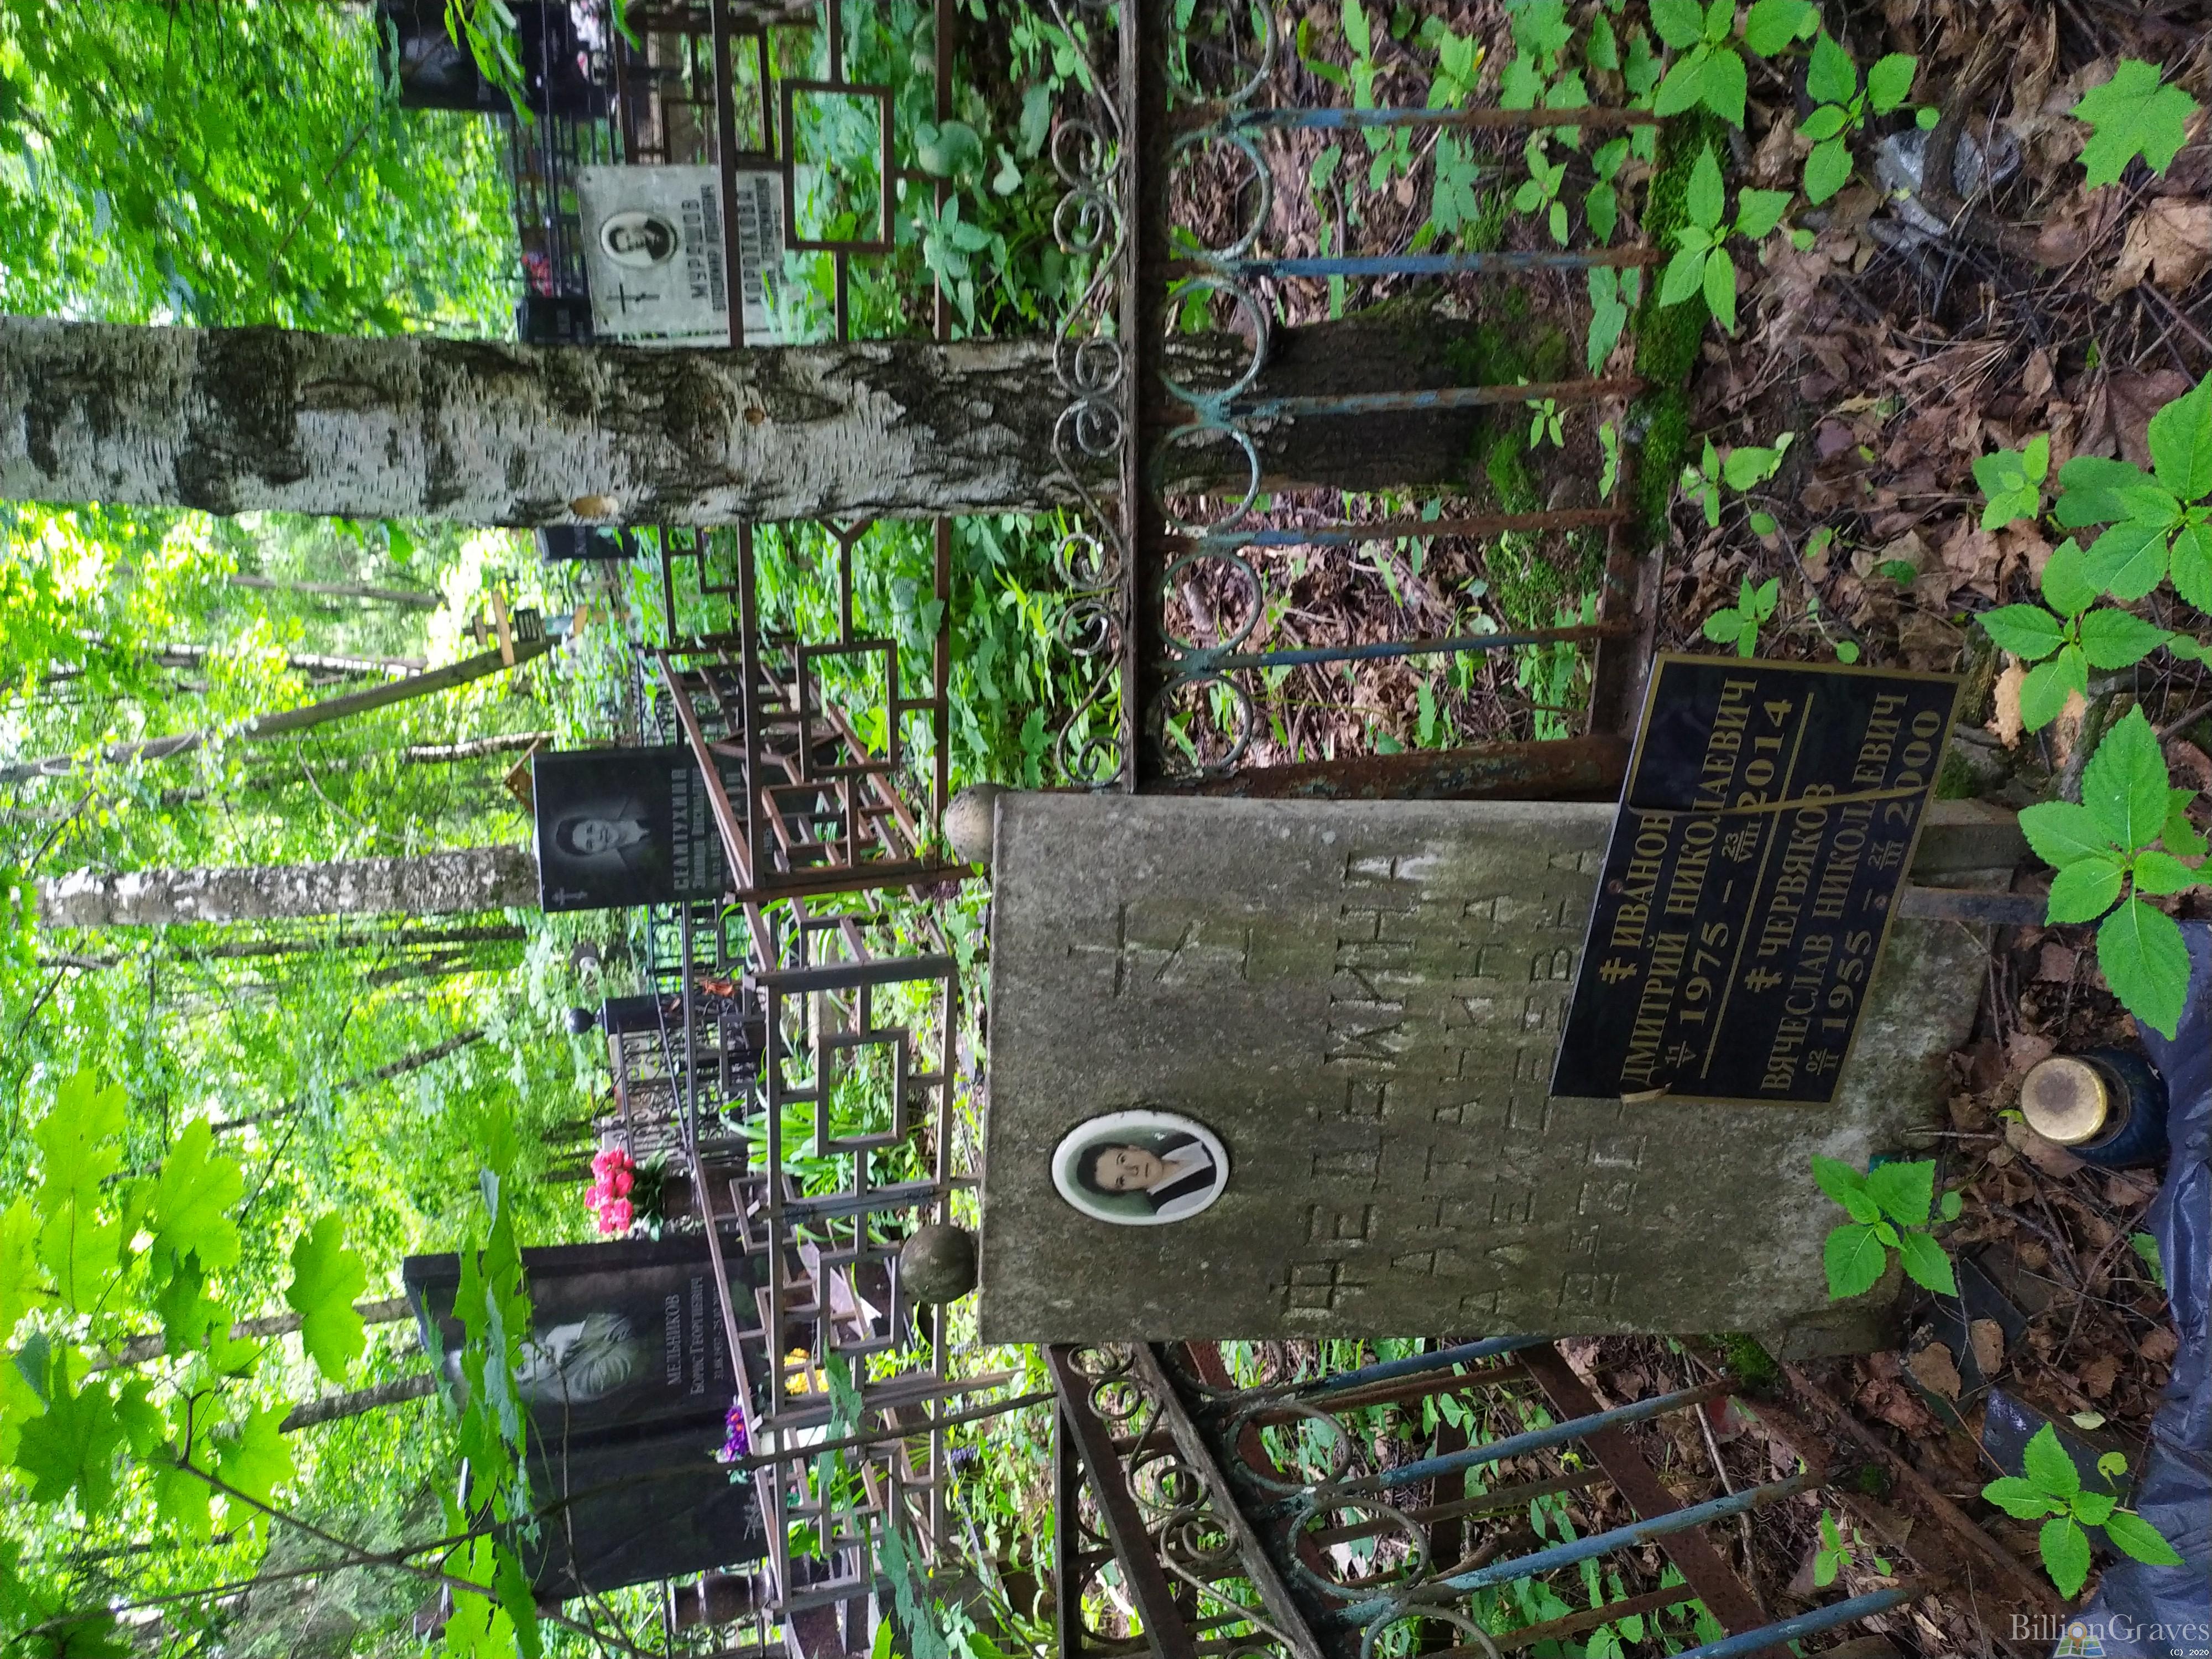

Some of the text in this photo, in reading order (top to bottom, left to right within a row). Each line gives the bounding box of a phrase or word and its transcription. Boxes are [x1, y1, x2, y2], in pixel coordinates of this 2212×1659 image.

[1609, 812, 1674, 949] ИВАНОВ
[1620, 677, 1757, 1086] ДМИТРИЙ НИКОЛАЕВИЧ
[1679, 920, 1729, 1025] 1975
[1736, 698, 1793, 815] 2014
[1756, 782, 1835, 957] ЧЕРВЯКОВ
[1760, 691, 1908, 1091] ВЯЧЕСЛАВ НИКОЛЕВИЧ
[1822, 929, 1872, 1032] 1955
[1883, 709, 1942, 827] 2000
[665, 1293, 681, 1384] МЕЛЬНИКОВ
